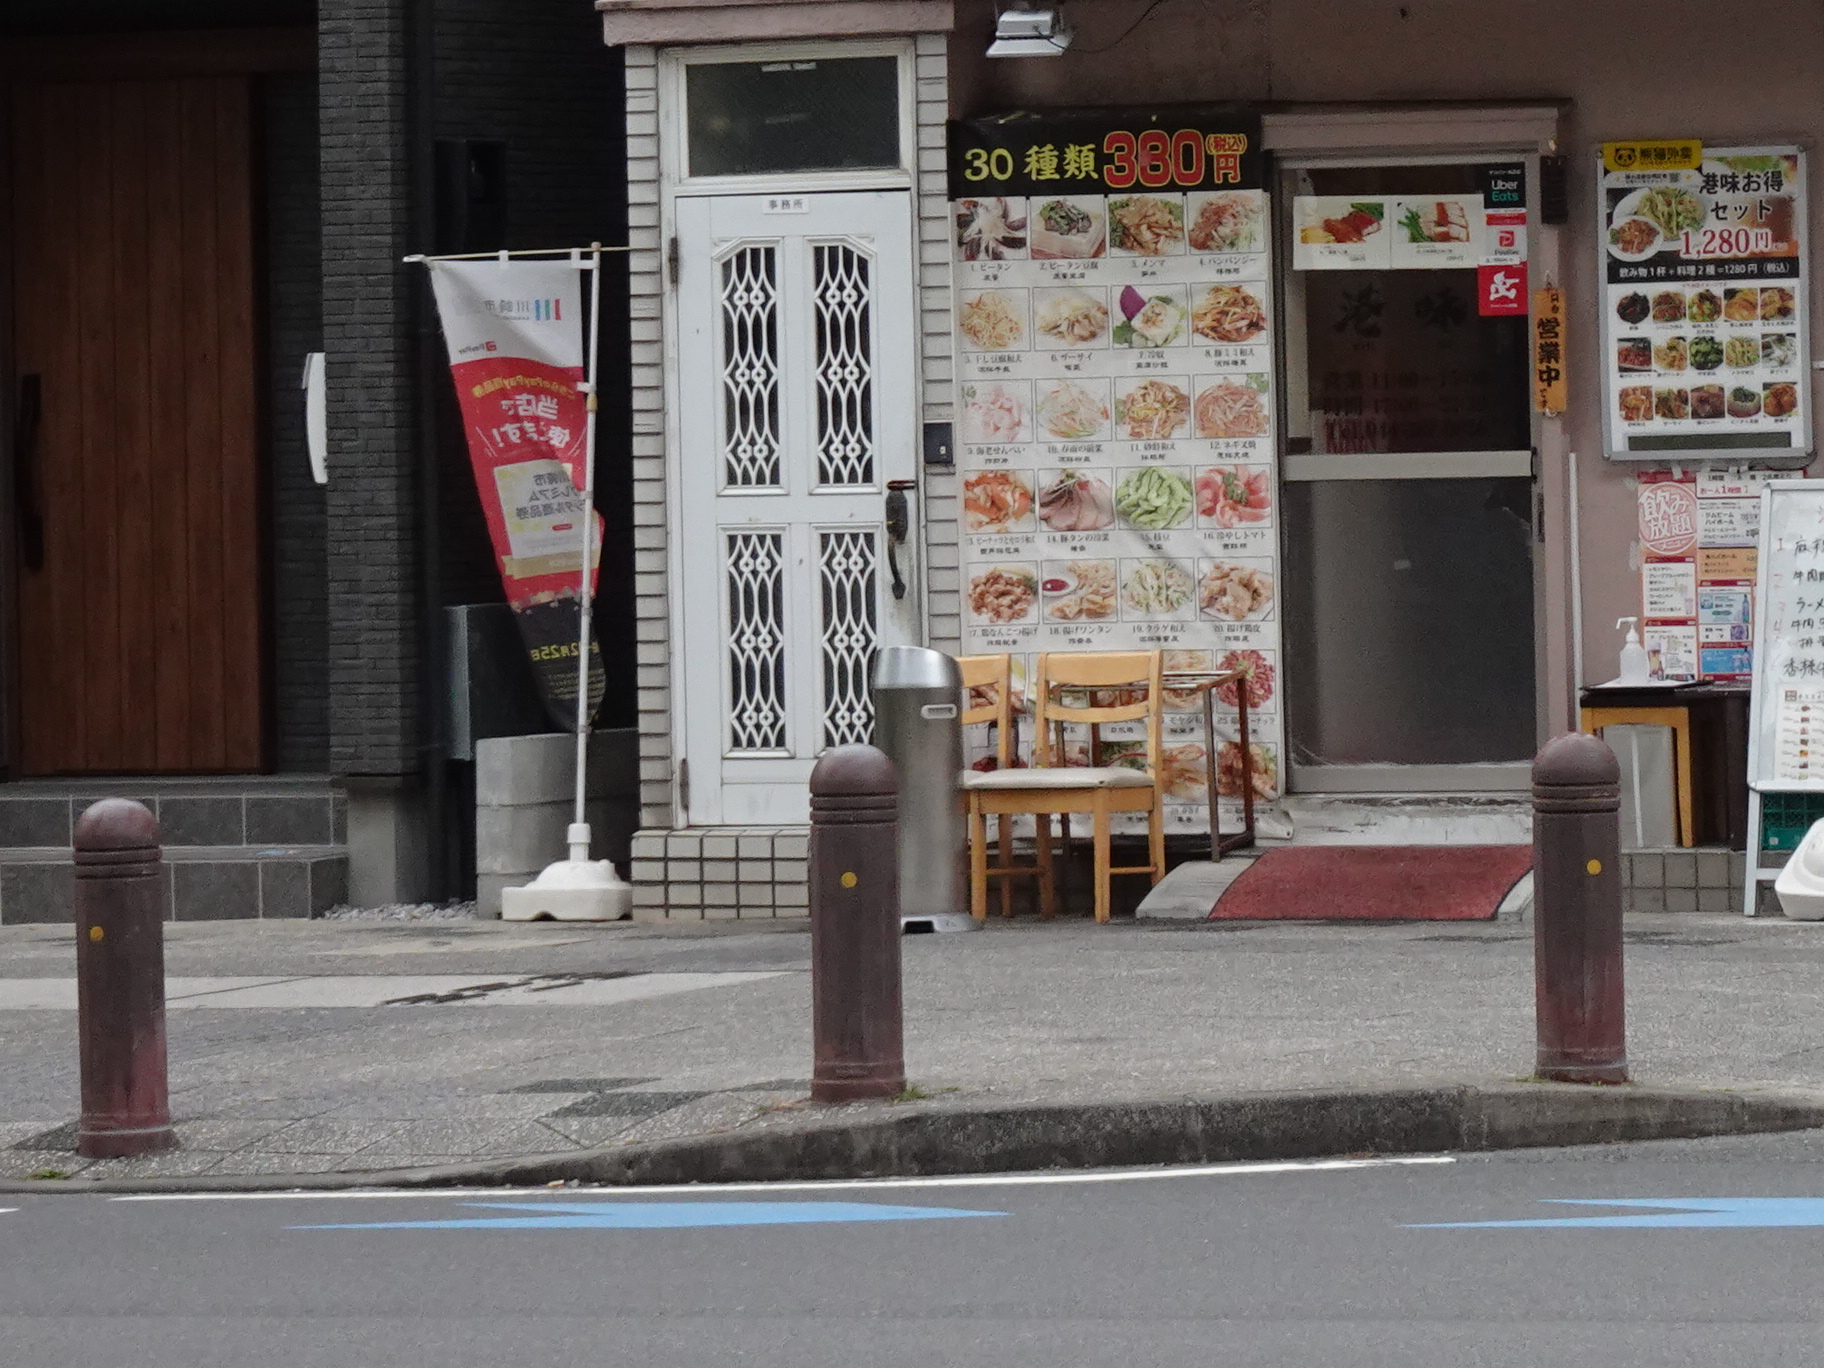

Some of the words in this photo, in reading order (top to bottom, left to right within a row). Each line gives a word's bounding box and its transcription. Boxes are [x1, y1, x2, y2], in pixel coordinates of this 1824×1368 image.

[1491, 179, 1518, 190] Uber
[1698, 170, 1784, 194] 港味お得
[1492, 191, 1519, 202] Eats
[1711, 199, 1771, 220] セット
[1537, 317, 1560, 387] 営業中
